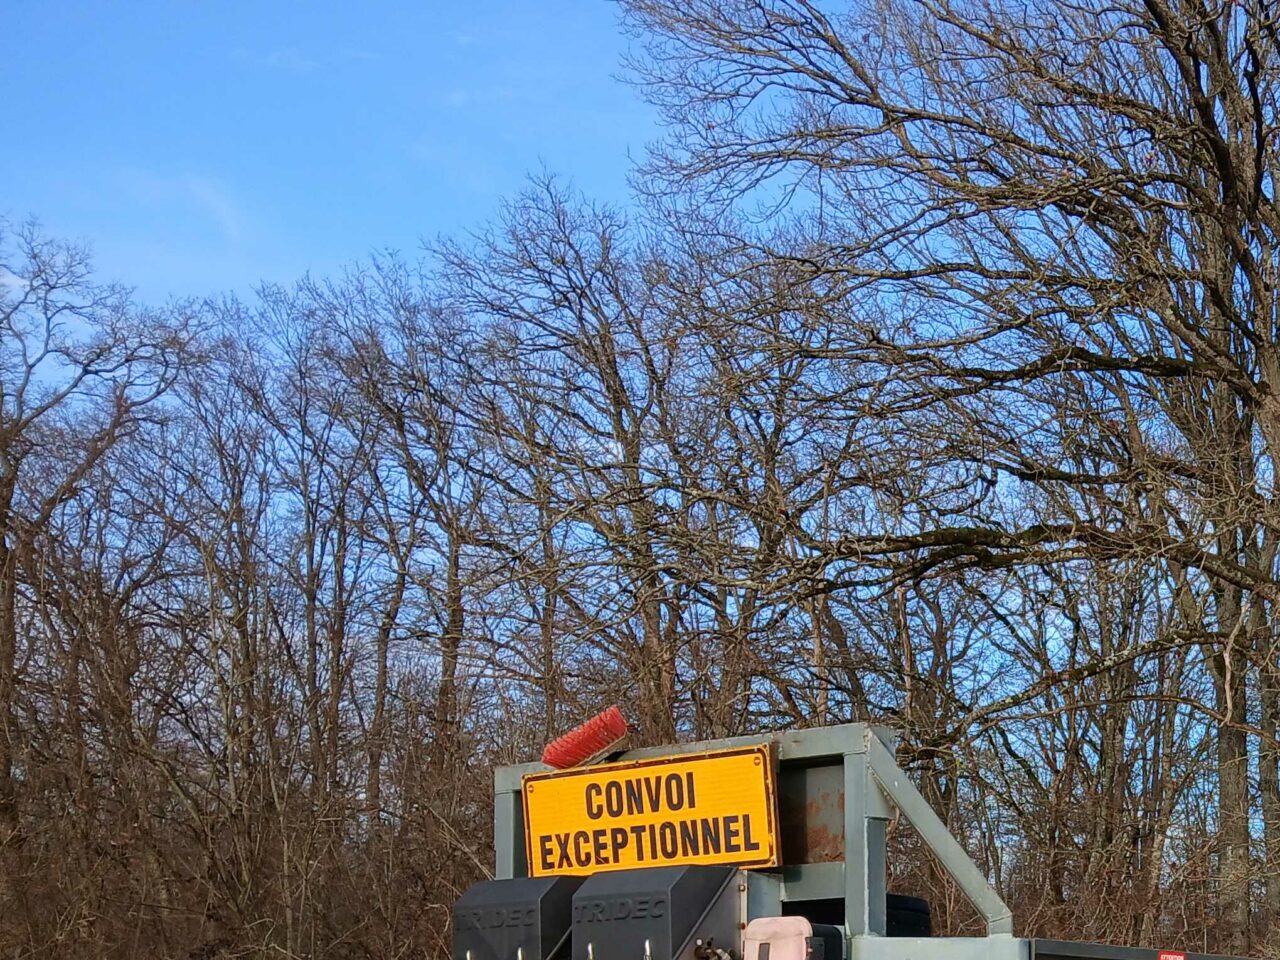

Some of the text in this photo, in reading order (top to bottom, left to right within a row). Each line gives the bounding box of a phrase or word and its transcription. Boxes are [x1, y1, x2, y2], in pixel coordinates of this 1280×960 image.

[585, 771, 696, 820] CONVOI
[539, 813, 760, 870] EXCEPTIONNEL
[455, 908, 536, 931] TRIDEC
[574, 899, 665, 924] TRIDEC
